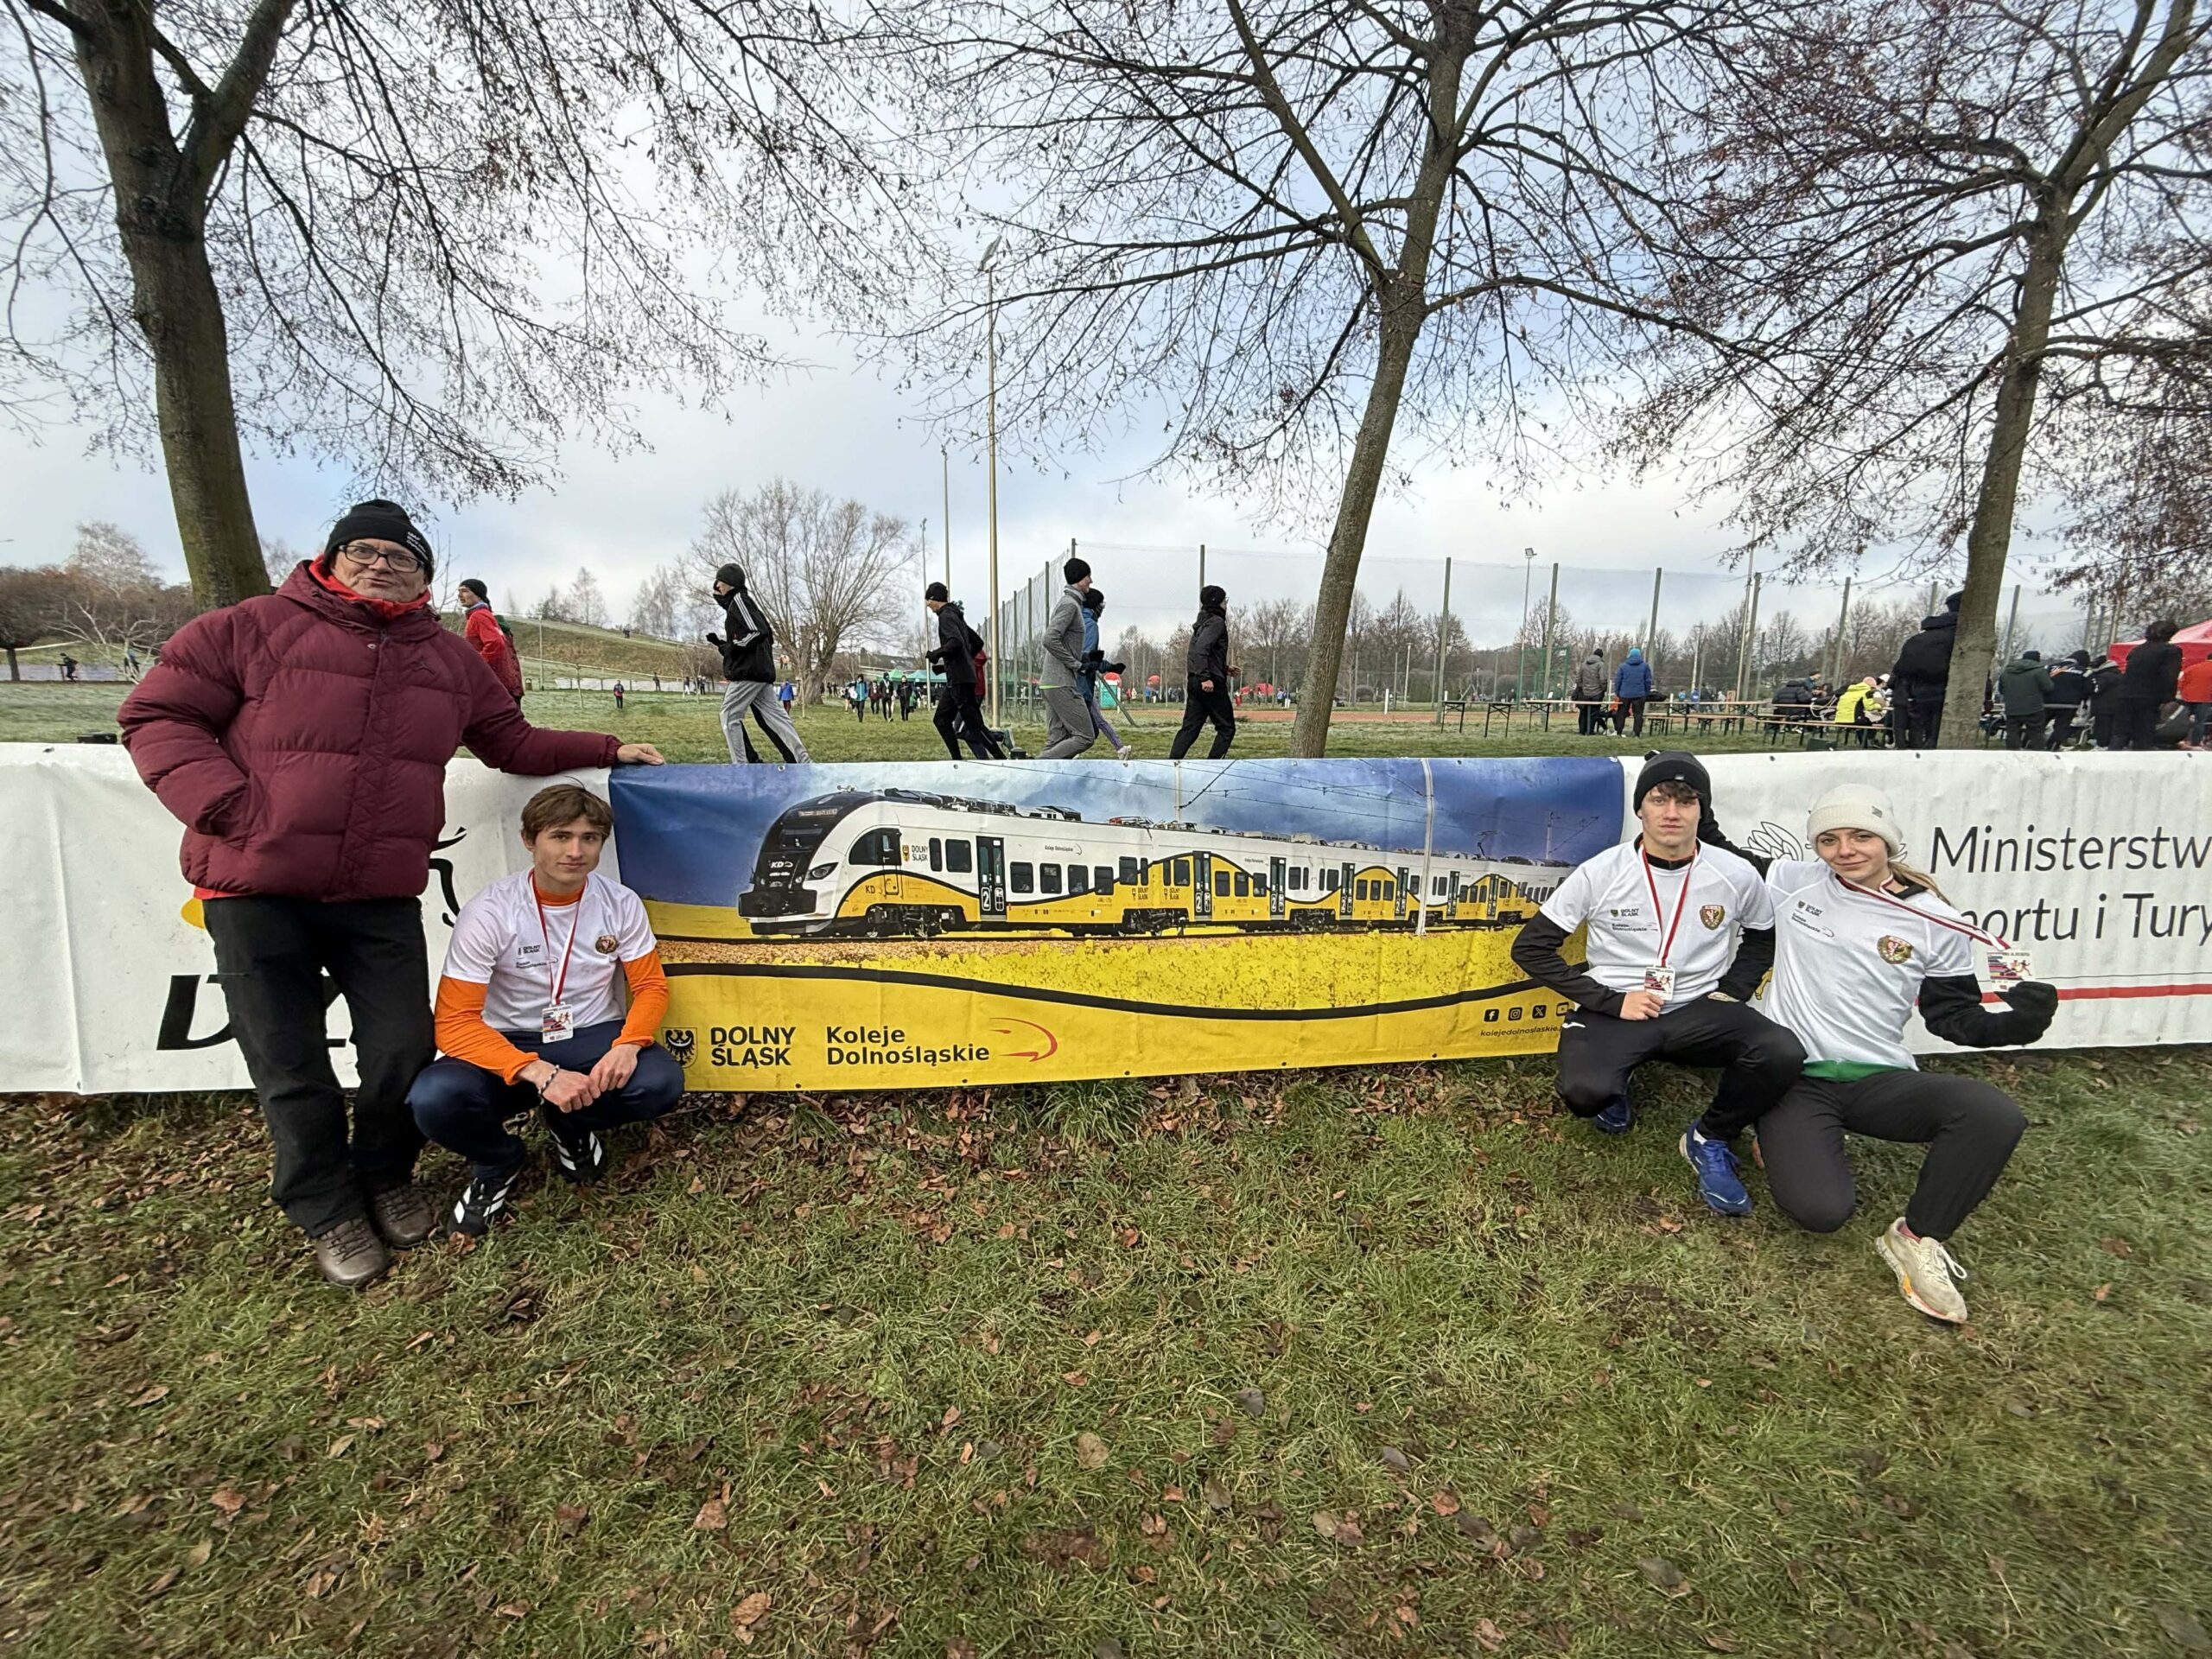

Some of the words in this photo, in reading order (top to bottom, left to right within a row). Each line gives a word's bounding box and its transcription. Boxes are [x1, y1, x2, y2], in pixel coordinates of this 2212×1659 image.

[1929, 824, 2212, 874] Ministerstw
[865, 885, 876, 894] KD
[1960, 899, 2079, 942] ortu
[2095, 893, 2107, 939] i
[710, 1026, 796, 1046] DOLNY
[826, 1026, 906, 1047] Koleje
[710, 1044, 791, 1069] ŚLĄSK
[827, 1043, 989, 1066] Dolnośląskie
